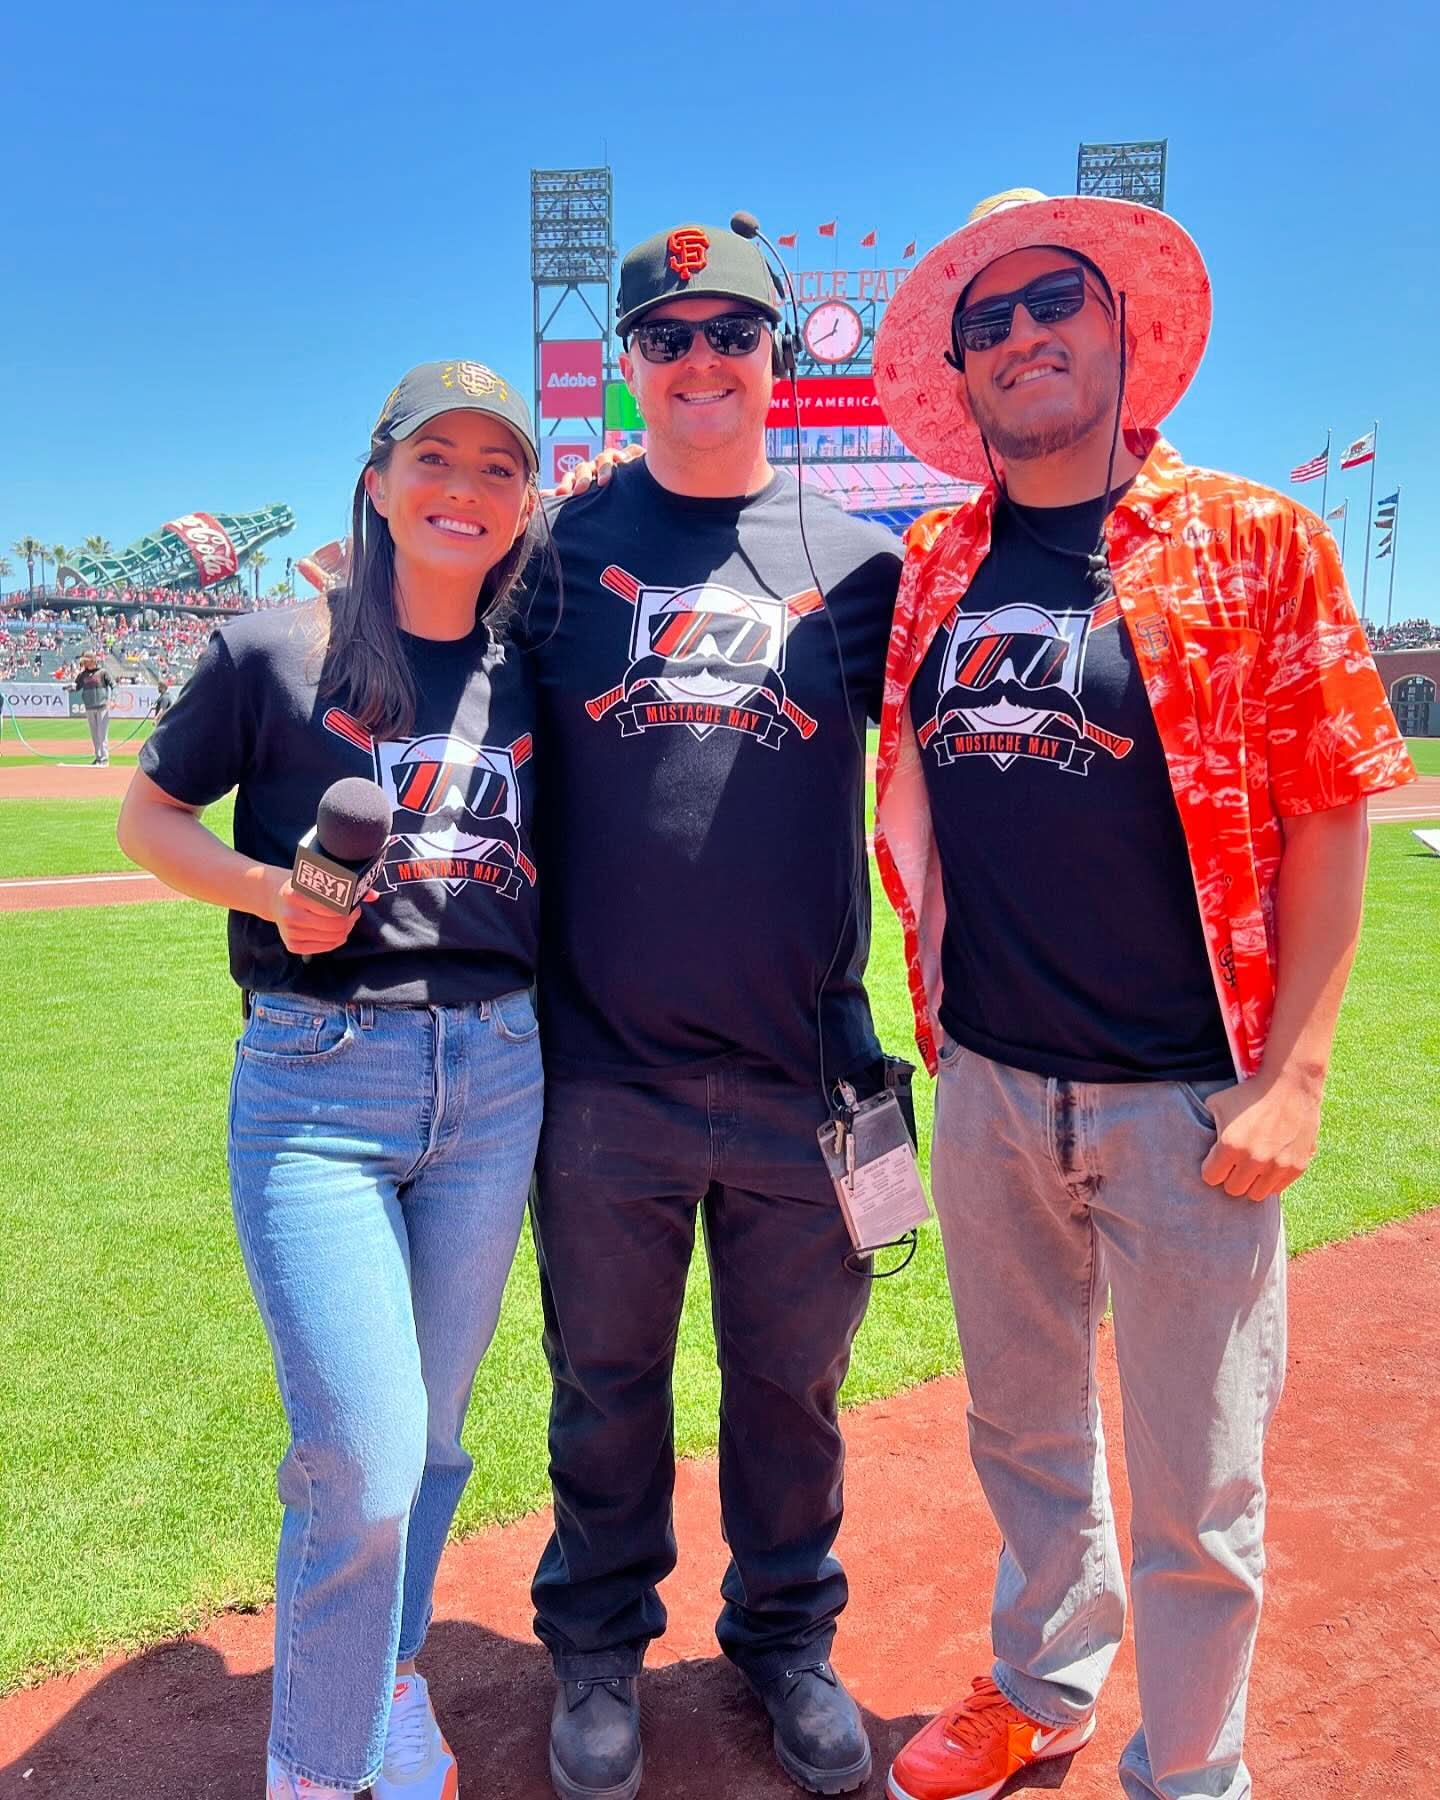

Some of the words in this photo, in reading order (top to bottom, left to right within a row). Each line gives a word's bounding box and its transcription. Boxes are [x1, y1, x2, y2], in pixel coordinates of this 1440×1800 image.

[670, 228, 709, 280] SF
[547, 372, 598, 388] Adobe
[796, 398, 812, 409] OF
[815, 396, 880, 408] AMERICA
[1135, 614, 1170, 660] SF
[4, 694, 63, 706] OYOTA
[646, 703, 721, 723] MUSTACHE
[728, 708, 760, 731] MAY
[955, 734, 1021, 753] MUSTACHE
[1028, 737, 1059, 759] MAY
[301, 863, 337, 887] SAY
[398, 860, 470, 881] MUSTACHE
[473, 863, 501, 883] MAY
